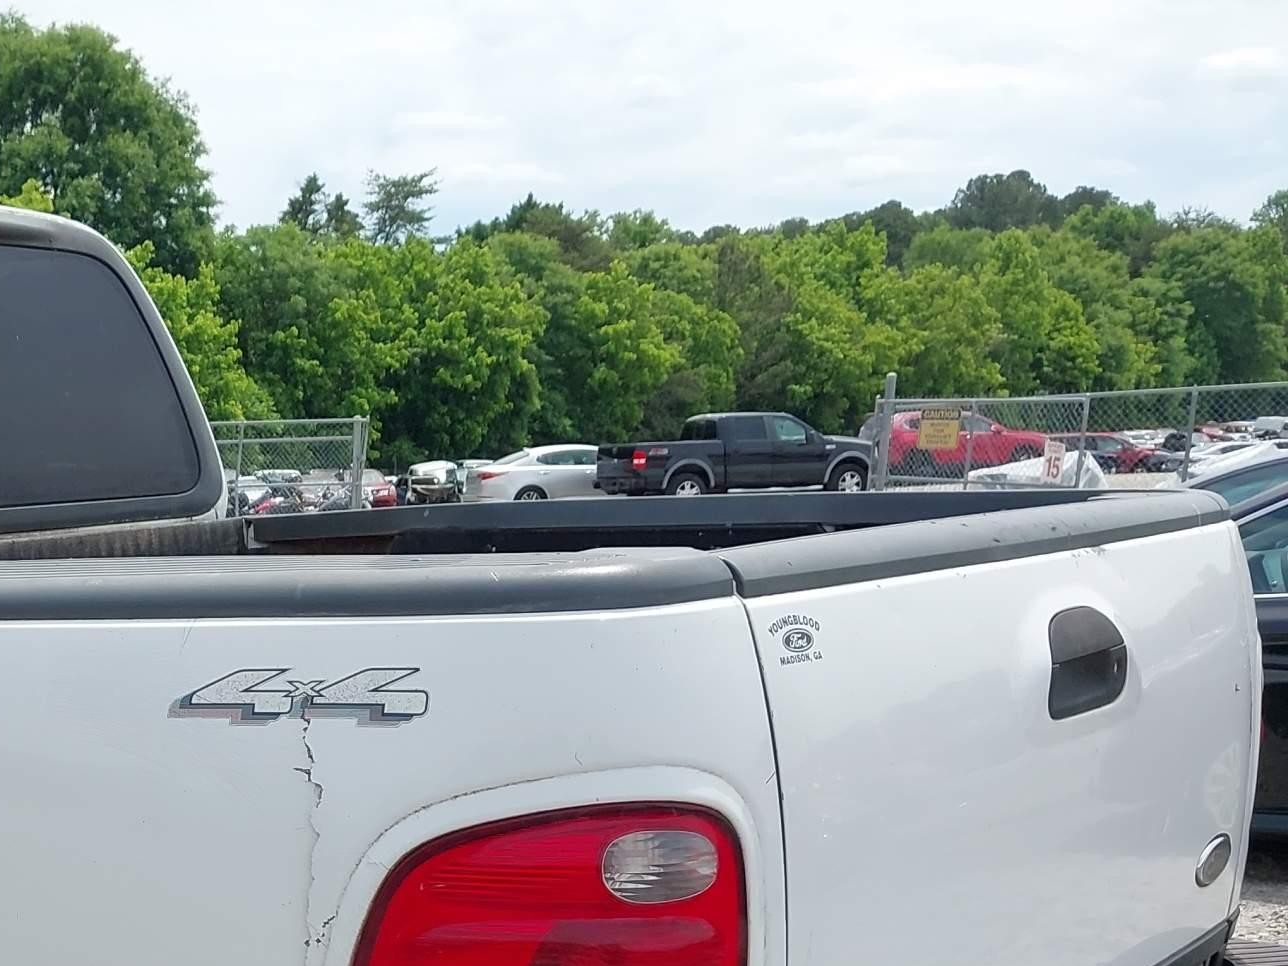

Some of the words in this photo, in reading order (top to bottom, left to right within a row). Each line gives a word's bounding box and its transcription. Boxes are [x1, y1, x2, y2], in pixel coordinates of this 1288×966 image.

[922, 409, 959, 419] CAUTION
[1045, 455, 1061, 479] 15
[768, 614, 821, 637] YOUNGBLOOD
[779, 653, 813, 666] MADISON,
[813, 650, 824, 661] GA
